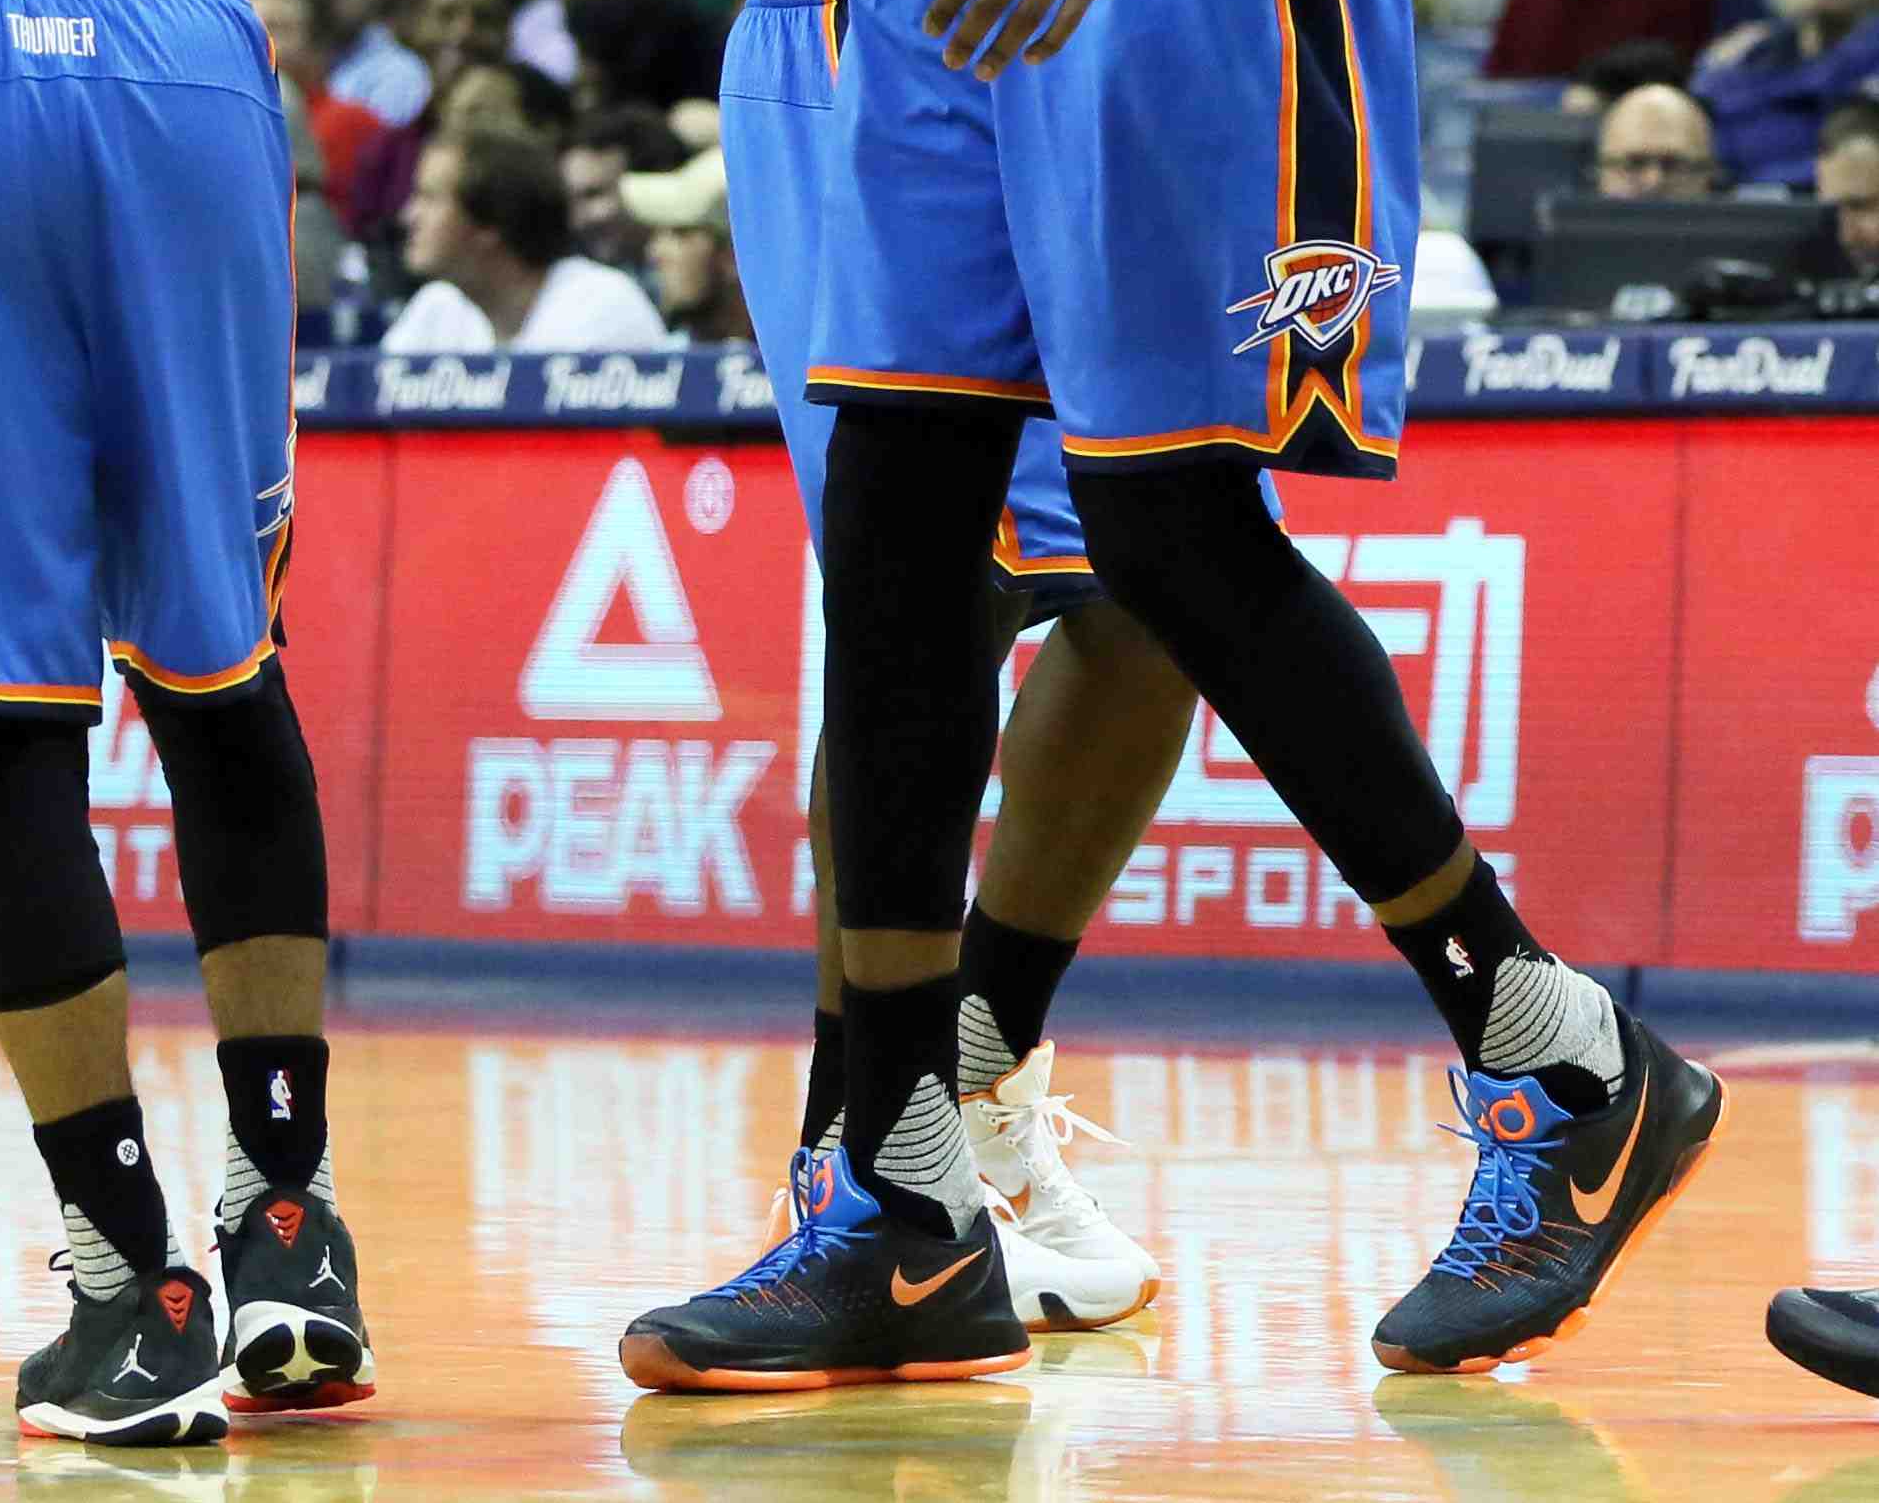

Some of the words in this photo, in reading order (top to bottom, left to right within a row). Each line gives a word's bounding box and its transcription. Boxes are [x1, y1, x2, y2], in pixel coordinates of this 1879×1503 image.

[6, 12, 96, 57] THUNDER
[1265, 263, 1355, 325] OKC
[461, 737, 778, 915] PEAK
[1107, 844, 1518, 928] SPOR
